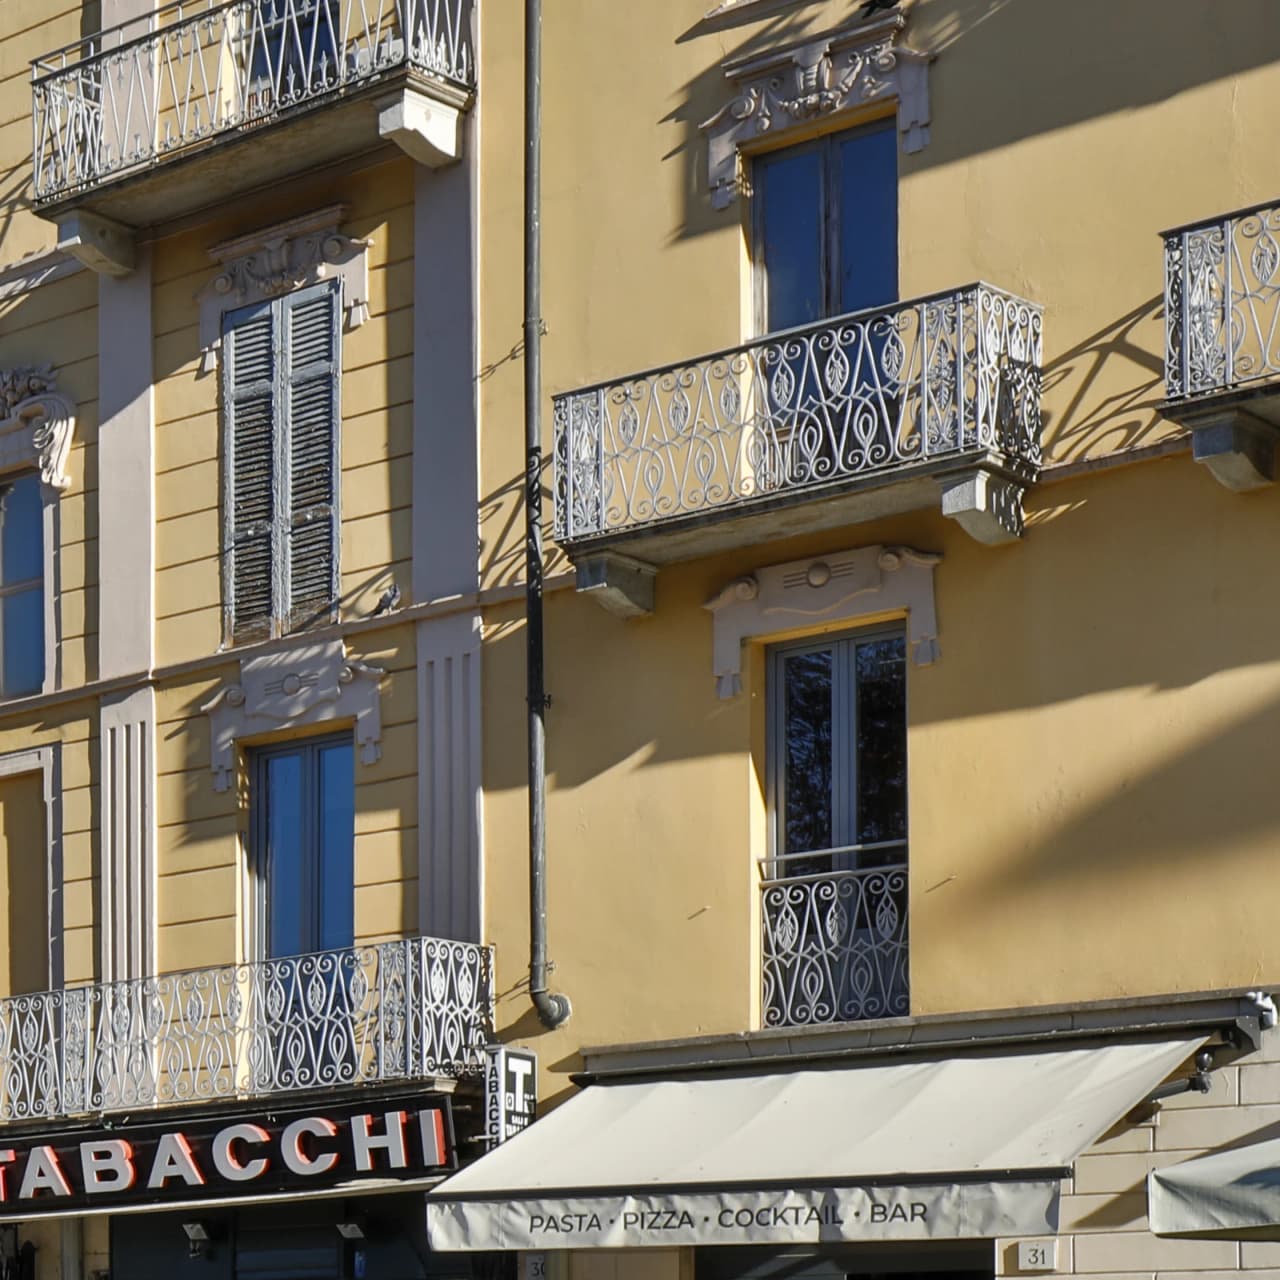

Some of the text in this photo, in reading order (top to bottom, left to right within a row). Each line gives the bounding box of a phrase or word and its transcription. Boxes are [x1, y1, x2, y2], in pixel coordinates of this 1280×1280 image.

[529, 1202, 928, 1234] PASTA PIZZA COCKTAIL BAR
[1028, 1248, 1046, 1265] 31
